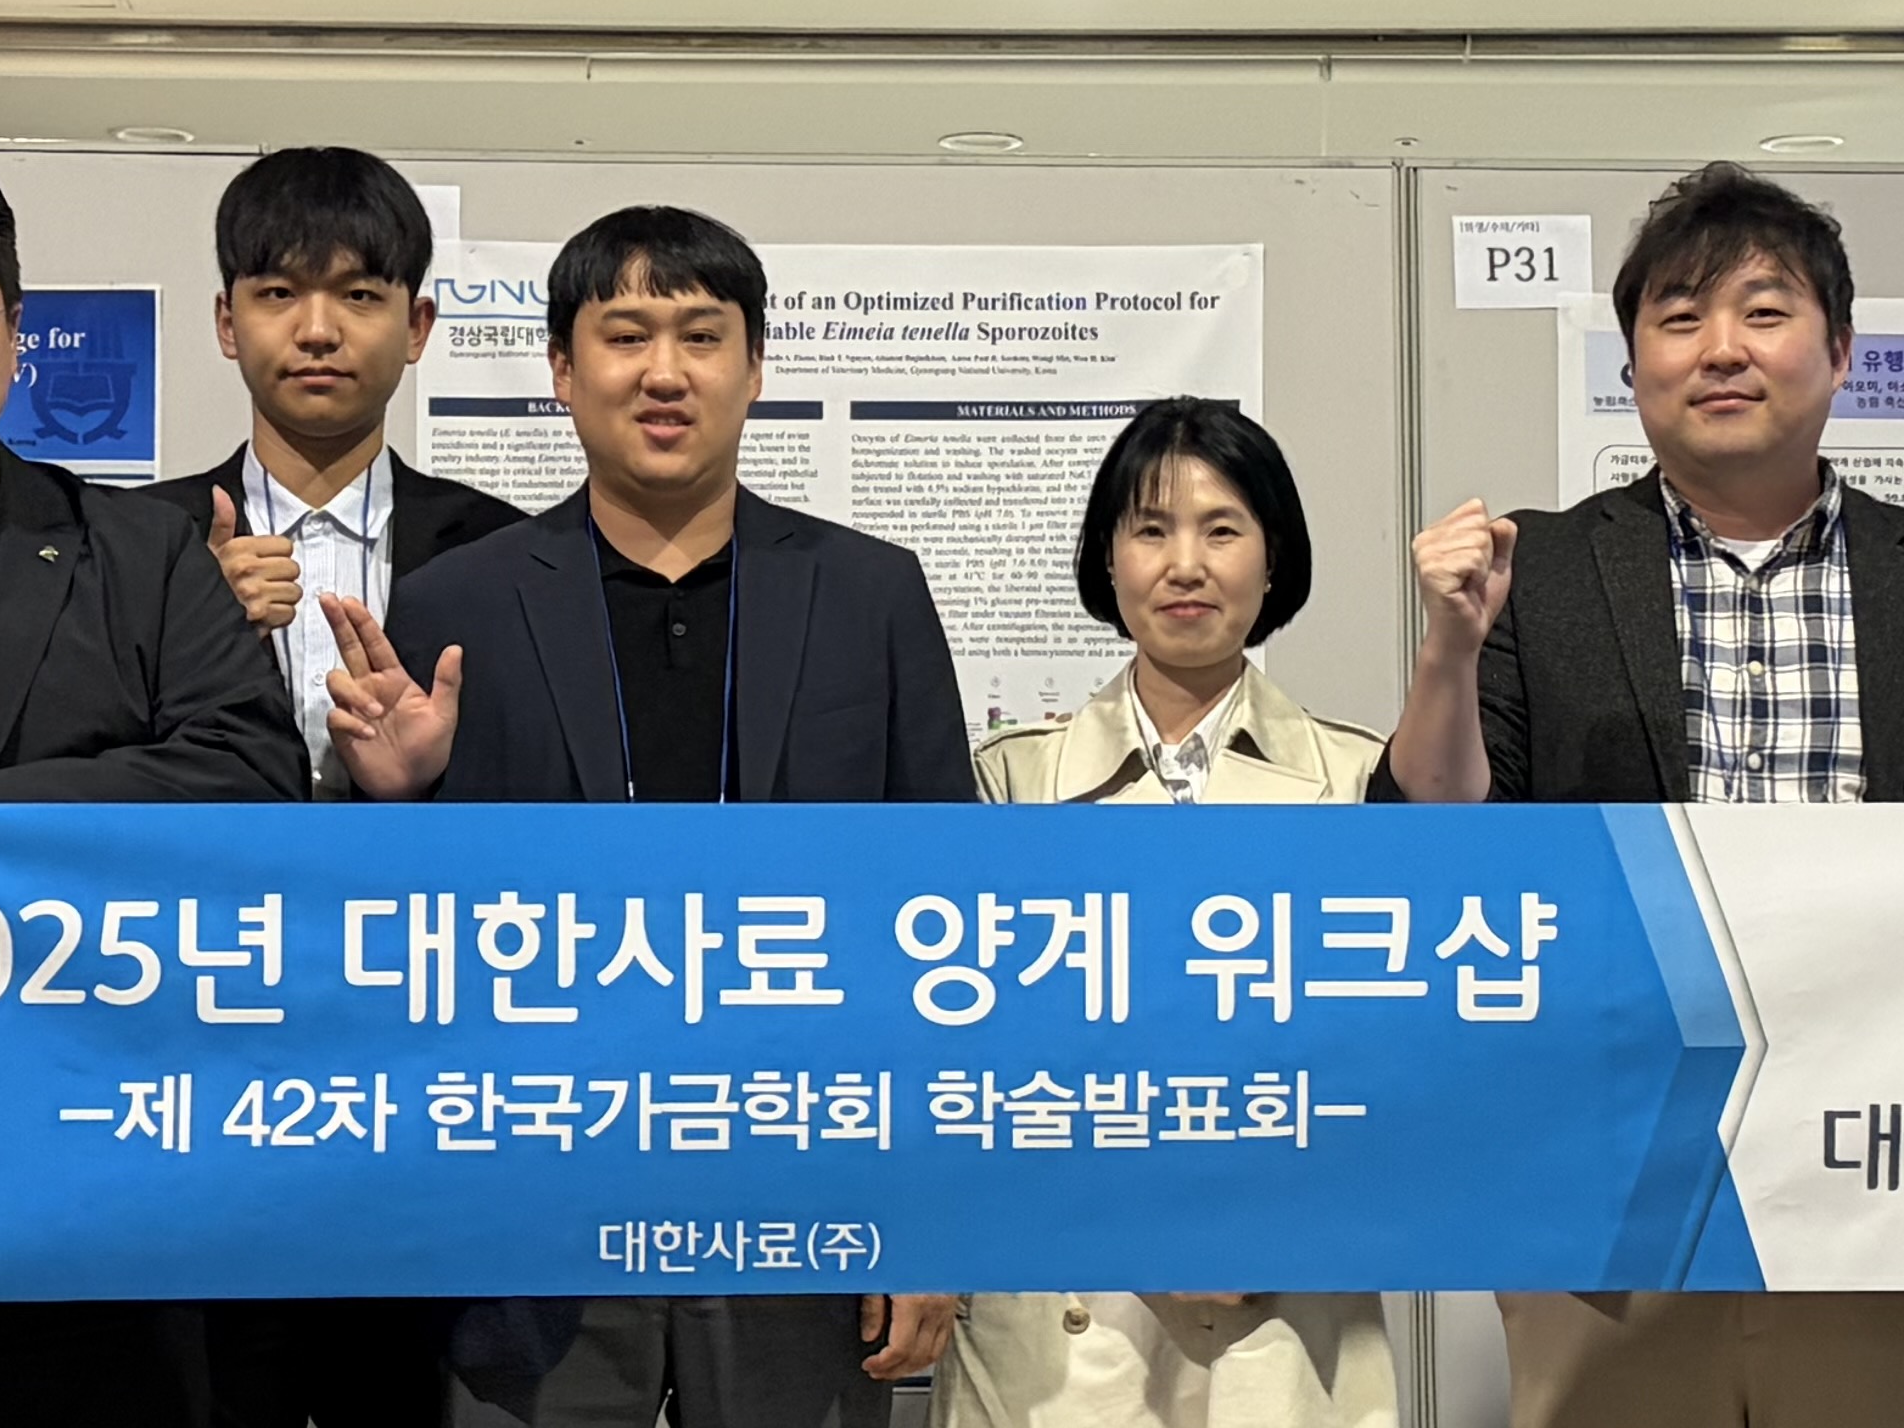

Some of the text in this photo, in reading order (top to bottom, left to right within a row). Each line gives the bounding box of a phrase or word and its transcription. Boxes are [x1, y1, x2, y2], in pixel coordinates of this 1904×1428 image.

[1486, 246, 1559, 282] P31
[783, 291, 1221, 316] of an Optimized Purification Protocol for
[48, 327, 87, 350] for
[764, 321, 1100, 346] iable Eimeia tenella Sporozoites
[1862, 350, 1904, 372] 유행
[957, 405, 1137, 418] MATERIALS AND METHODS
[341, 890, 845, 1025] 대한사료
[893, 890, 1131, 1027] 양계
[1182, 889, 1560, 1025] 워크샵
[222, 1071, 397, 1154] 42차
[425, 1070, 894, 1154] 한국가금학회
[597, 1217, 883, 1276] 대한사료(주)
